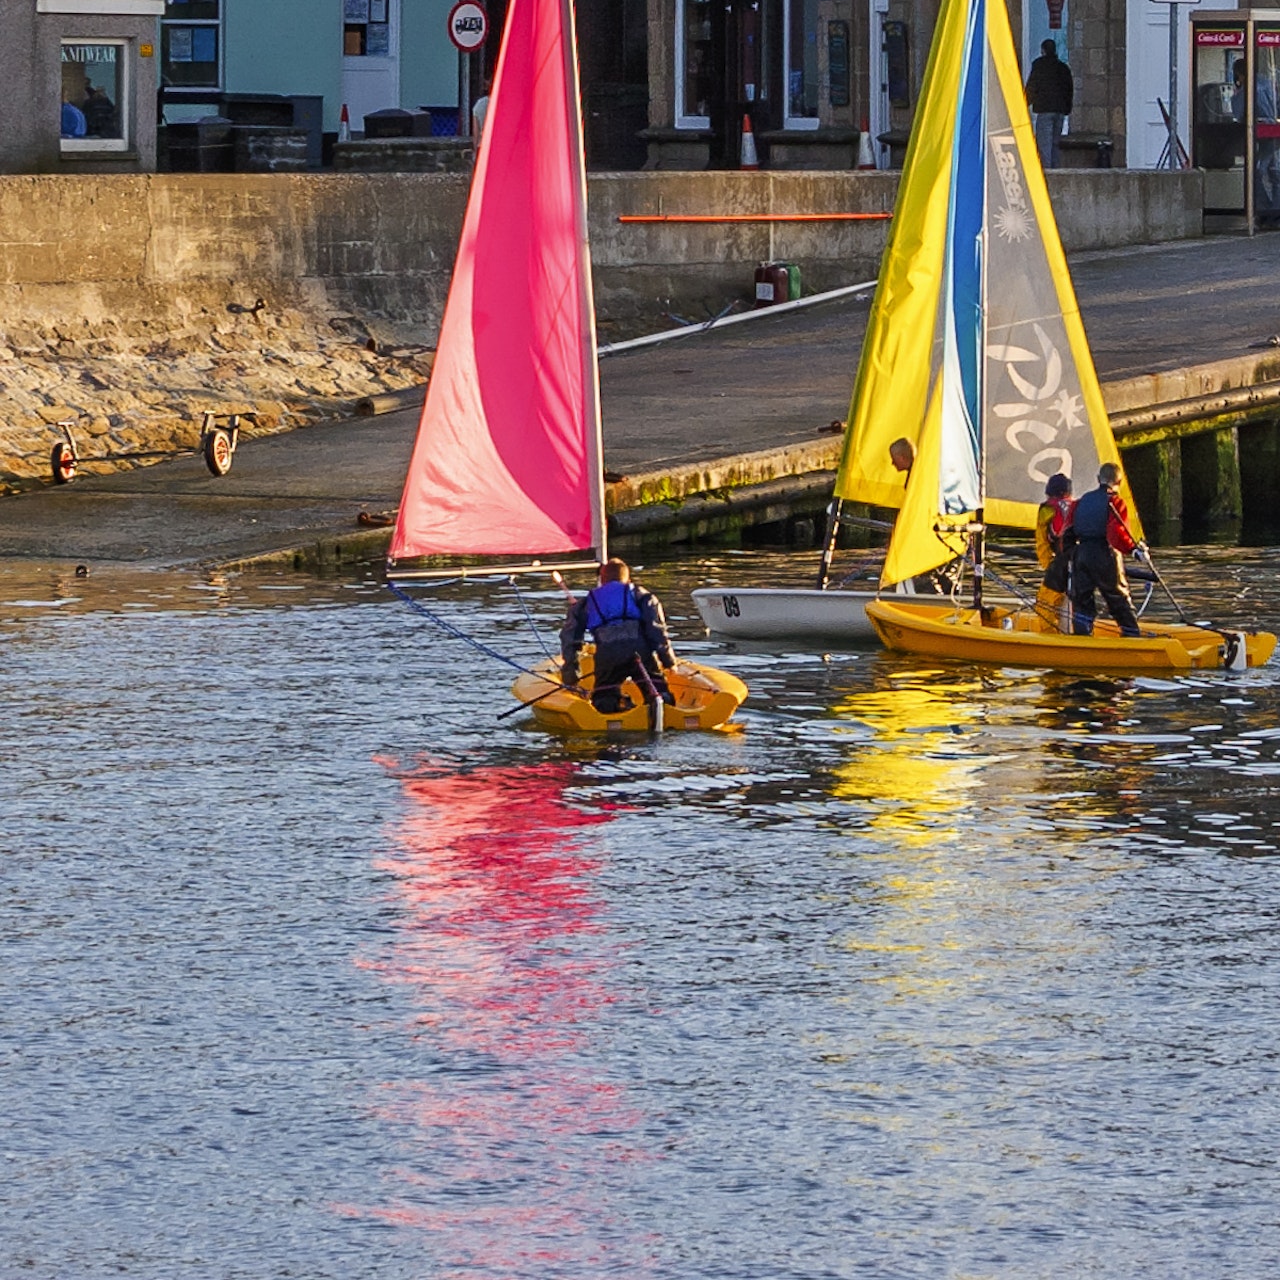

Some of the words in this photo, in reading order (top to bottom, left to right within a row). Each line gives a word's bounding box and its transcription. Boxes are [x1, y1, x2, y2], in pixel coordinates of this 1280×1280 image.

[60, 46, 116, 62] KNITWEAR
[989, 135, 1027, 211] Laser
[985, 323, 1078, 490] Pico
[722, 595, 741, 618] 09
